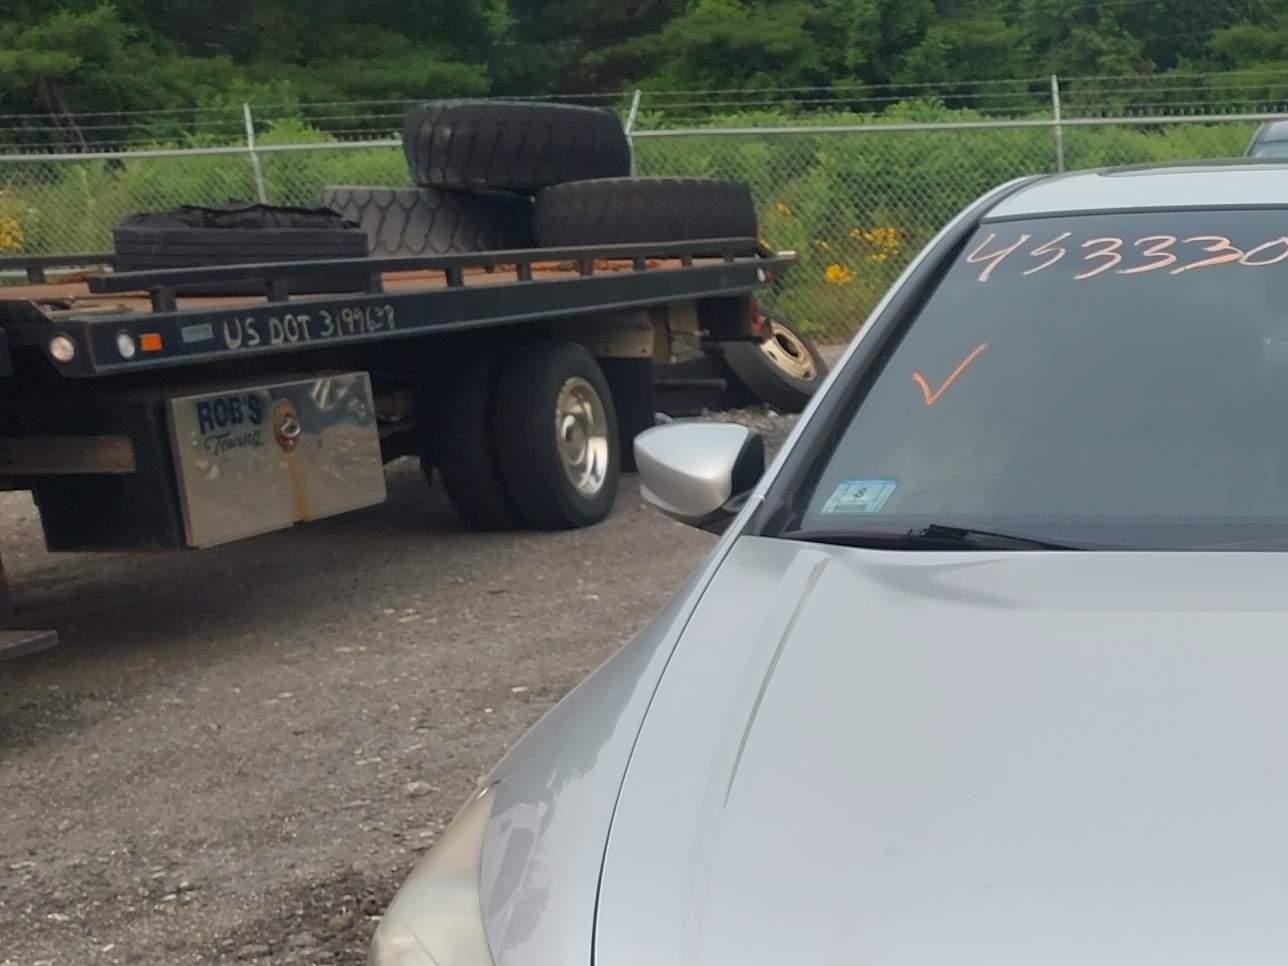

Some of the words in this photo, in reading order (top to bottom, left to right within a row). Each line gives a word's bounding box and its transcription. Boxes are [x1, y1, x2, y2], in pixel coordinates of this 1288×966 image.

[223, 316, 261, 350] US
[269, 313, 312, 346] DOT
[197, 394, 264, 436] ROB'S
[204, 430, 266, 457] Towing
